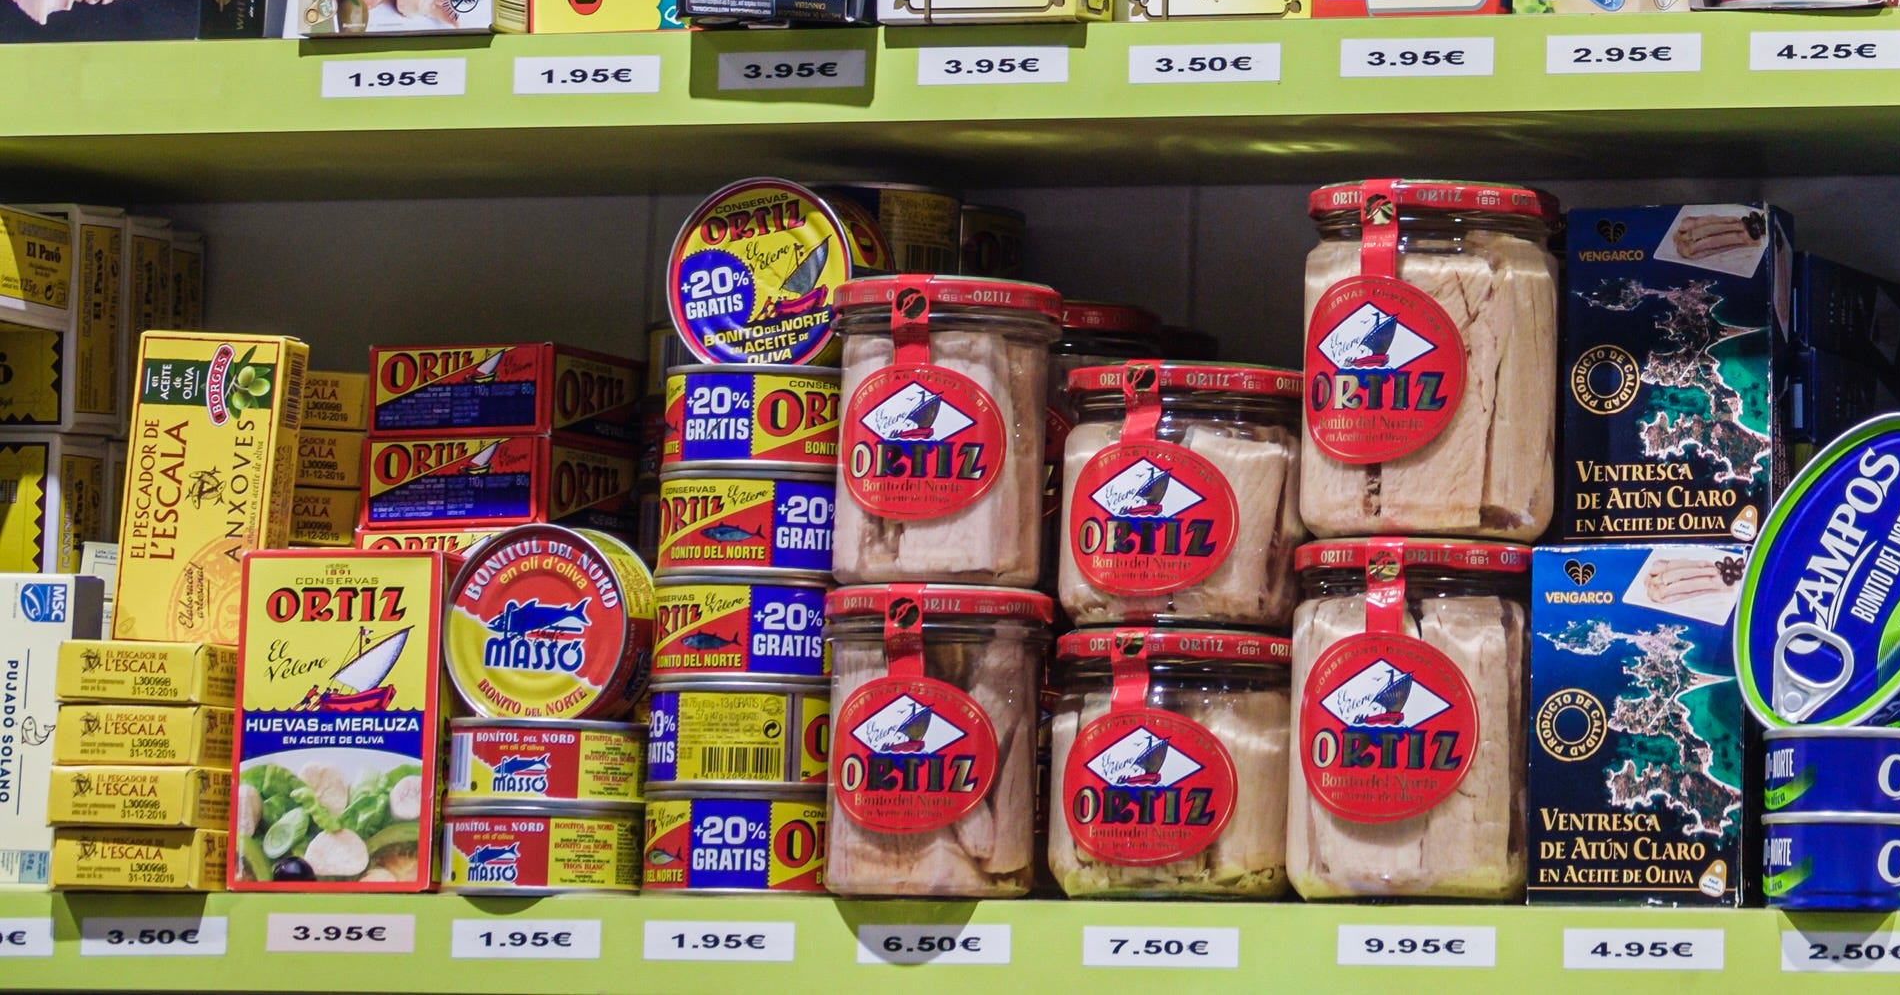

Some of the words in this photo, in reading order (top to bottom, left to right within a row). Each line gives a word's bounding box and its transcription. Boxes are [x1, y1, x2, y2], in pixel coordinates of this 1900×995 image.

[1366, 50, 1466, 66] 3.95€
[1572, 46, 1673, 63] 2.95€
[1776, 43, 1878, 60] 4.25€
[742, 60, 839, 78] 3.95€
[943, 56, 1040, 75] 3.95€
[1154, 55, 1253, 73] 3.50€
[347, 69, 440, 88] 1.95€
[540, 67, 633, 85] 1.95€
[210, 352, 230, 417] BORGES
[1310, 371, 1447, 412] ORTIZ
[849, 442, 986, 479] ORTIZ
[224, 419, 255, 561] ANXOVES
[266, 586, 407, 622] ORTIZ
[1545, 591, 1613, 604] VENGARCO
[753, 603, 822, 630] +20%
[752, 633, 822, 658] GRATIS
[245, 718, 319, 732] HUEVAS
[335, 718, 419, 731] MERLUZA
[129, 749, 176, 759] 31-12-2019
[1540, 841, 1566, 859] DE
[106, 929, 200, 946] 3.50€
[292, 925, 387, 942] 3.95€
[478, 931, 573, 948] 1.95€
[670, 933, 766, 950] 1.95€
[881, 935, 983, 953] 6.50€
[1109, 938, 1210, 956] 7.50€
[1363, 937, 1467, 955] 9.95€
[1589, 941, 1694, 959] 4.95€
